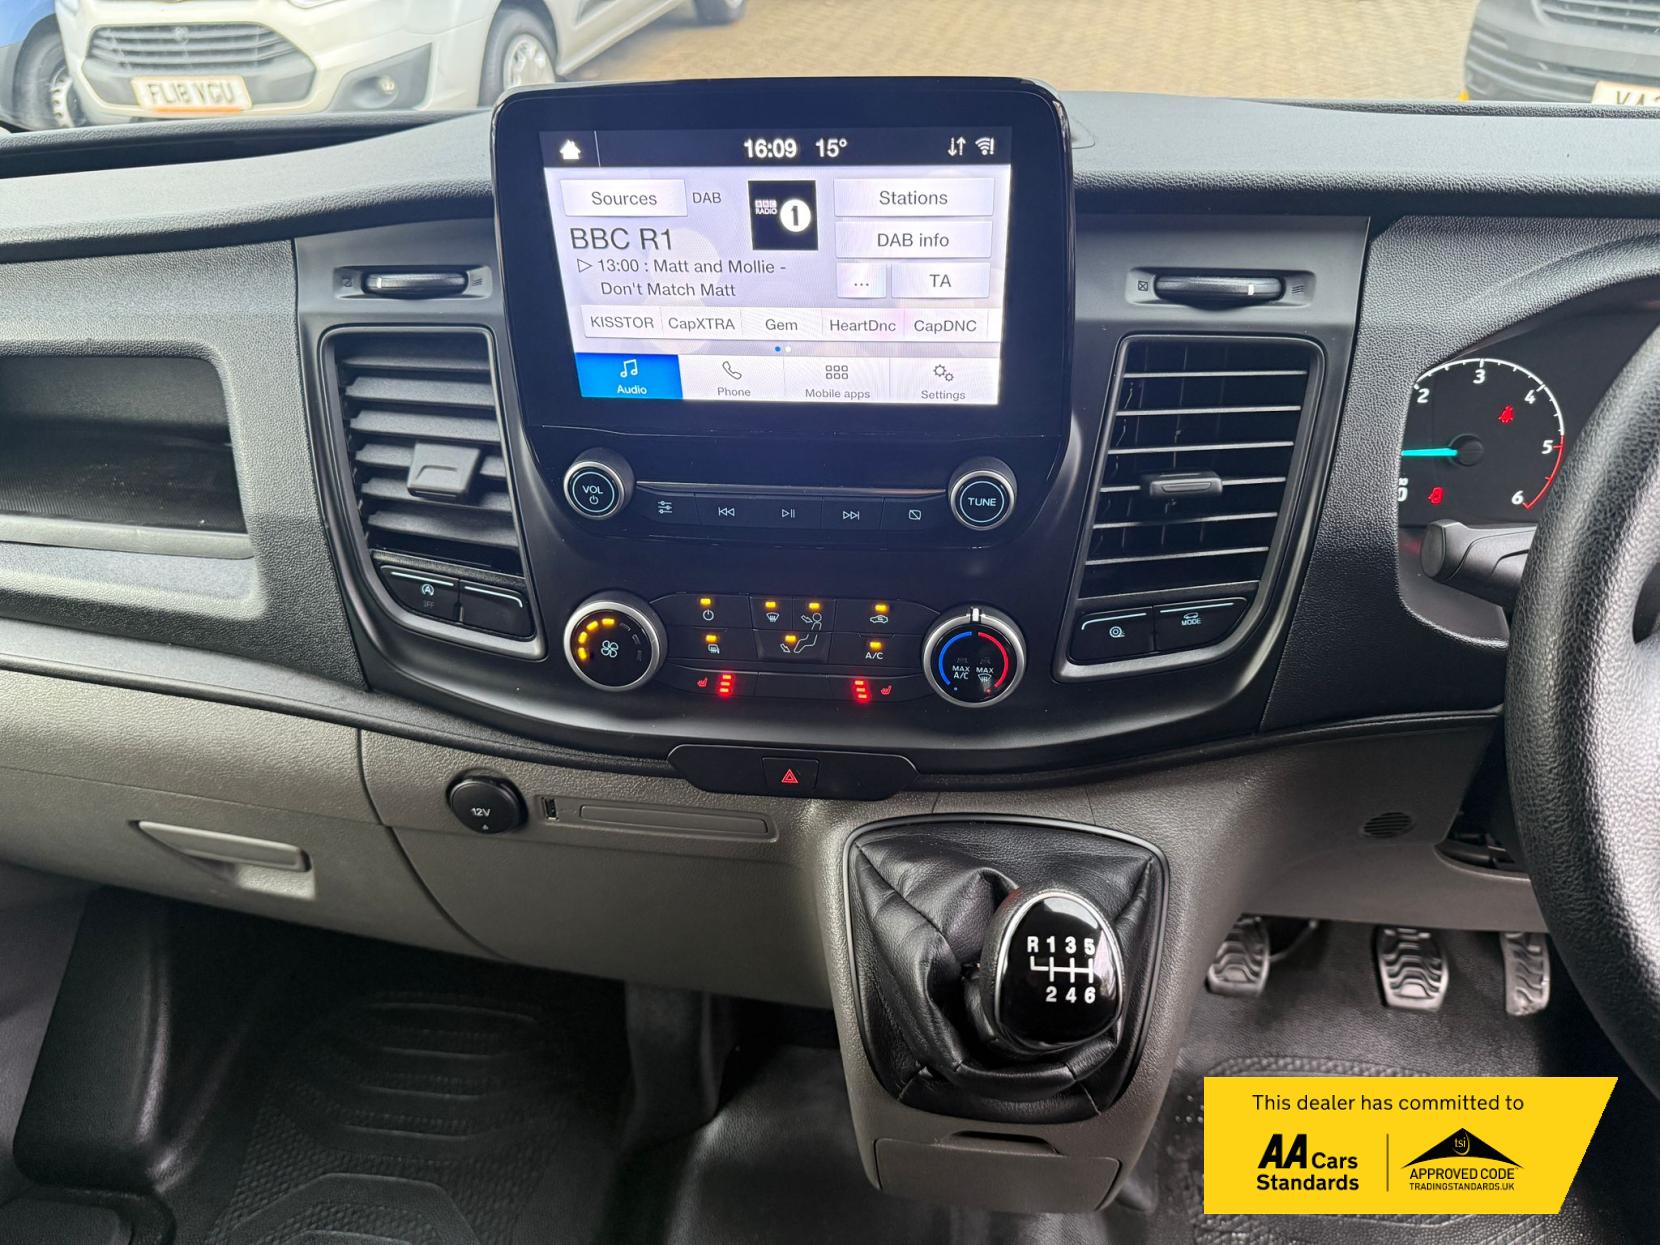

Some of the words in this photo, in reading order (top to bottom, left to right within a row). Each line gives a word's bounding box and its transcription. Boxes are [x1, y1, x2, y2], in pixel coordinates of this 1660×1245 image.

[743, 138, 798, 158] 16:09
[815, 138, 848, 158] 15°
[591, 191, 658, 206] Sources
[692, 192, 722, 204] DAB
[879, 190, 948, 206] Stations
[755, 207, 778, 215] RADIO
[791, 205, 799, 226] 1
[570, 227, 630, 250] BBC
[639, 228, 672, 250] R1
[877, 233, 913, 247] DAB
[919, 232, 950, 248] info
[598, 259, 639, 272] 13:00
[653, 259, 689, 273] Matt
[694, 260, 722, 273] and
[728, 260, 775, 274] Mollie
[929, 274, 951, 288] TA
[600, 282, 642, 296] Don't
[647, 282, 695, 297] Match
[700, 283, 736, 297] Matt
[590, 315, 654, 329] KISSTOR
[668, 317, 735, 334] CapXTRA
[765, 319, 798, 331] Gem
[830, 320, 896, 332] HeartDnc
[914, 320, 977, 334] CapDNC
[1472, 368, 1486, 384] 3
[616, 384, 648, 395] Audio
[717, 387, 751, 397] Phone
[805, 388, 841, 398] Mobile
[844, 391, 871, 401] apps
[921, 390, 966, 401] Settings
[1416, 388, 1430, 404] 2
[1524, 390, 1537, 404] 4
[1541, 439, 1553, 455] 5
[582, 485, 604, 494] VOL
[968, 497, 997, 507] TUNE
[1511, 490, 1524, 505] 6
[1181, 618, 1202, 626] MODE
[865, 652, 884, 660] A/C
[953, 671, 969, 680] A/C
[470, 807, 491, 817] 12V
[1027, 936, 1039, 953] R
[1046, 935, 1055, 953] 1
[1065, 936, 1077, 954] 3
[1084, 938, 1095, 955] 5
[1045, 986, 1057, 1002] 2
[1065, 987, 1077, 1003] 4
[1084, 986, 1096, 1004] 6
